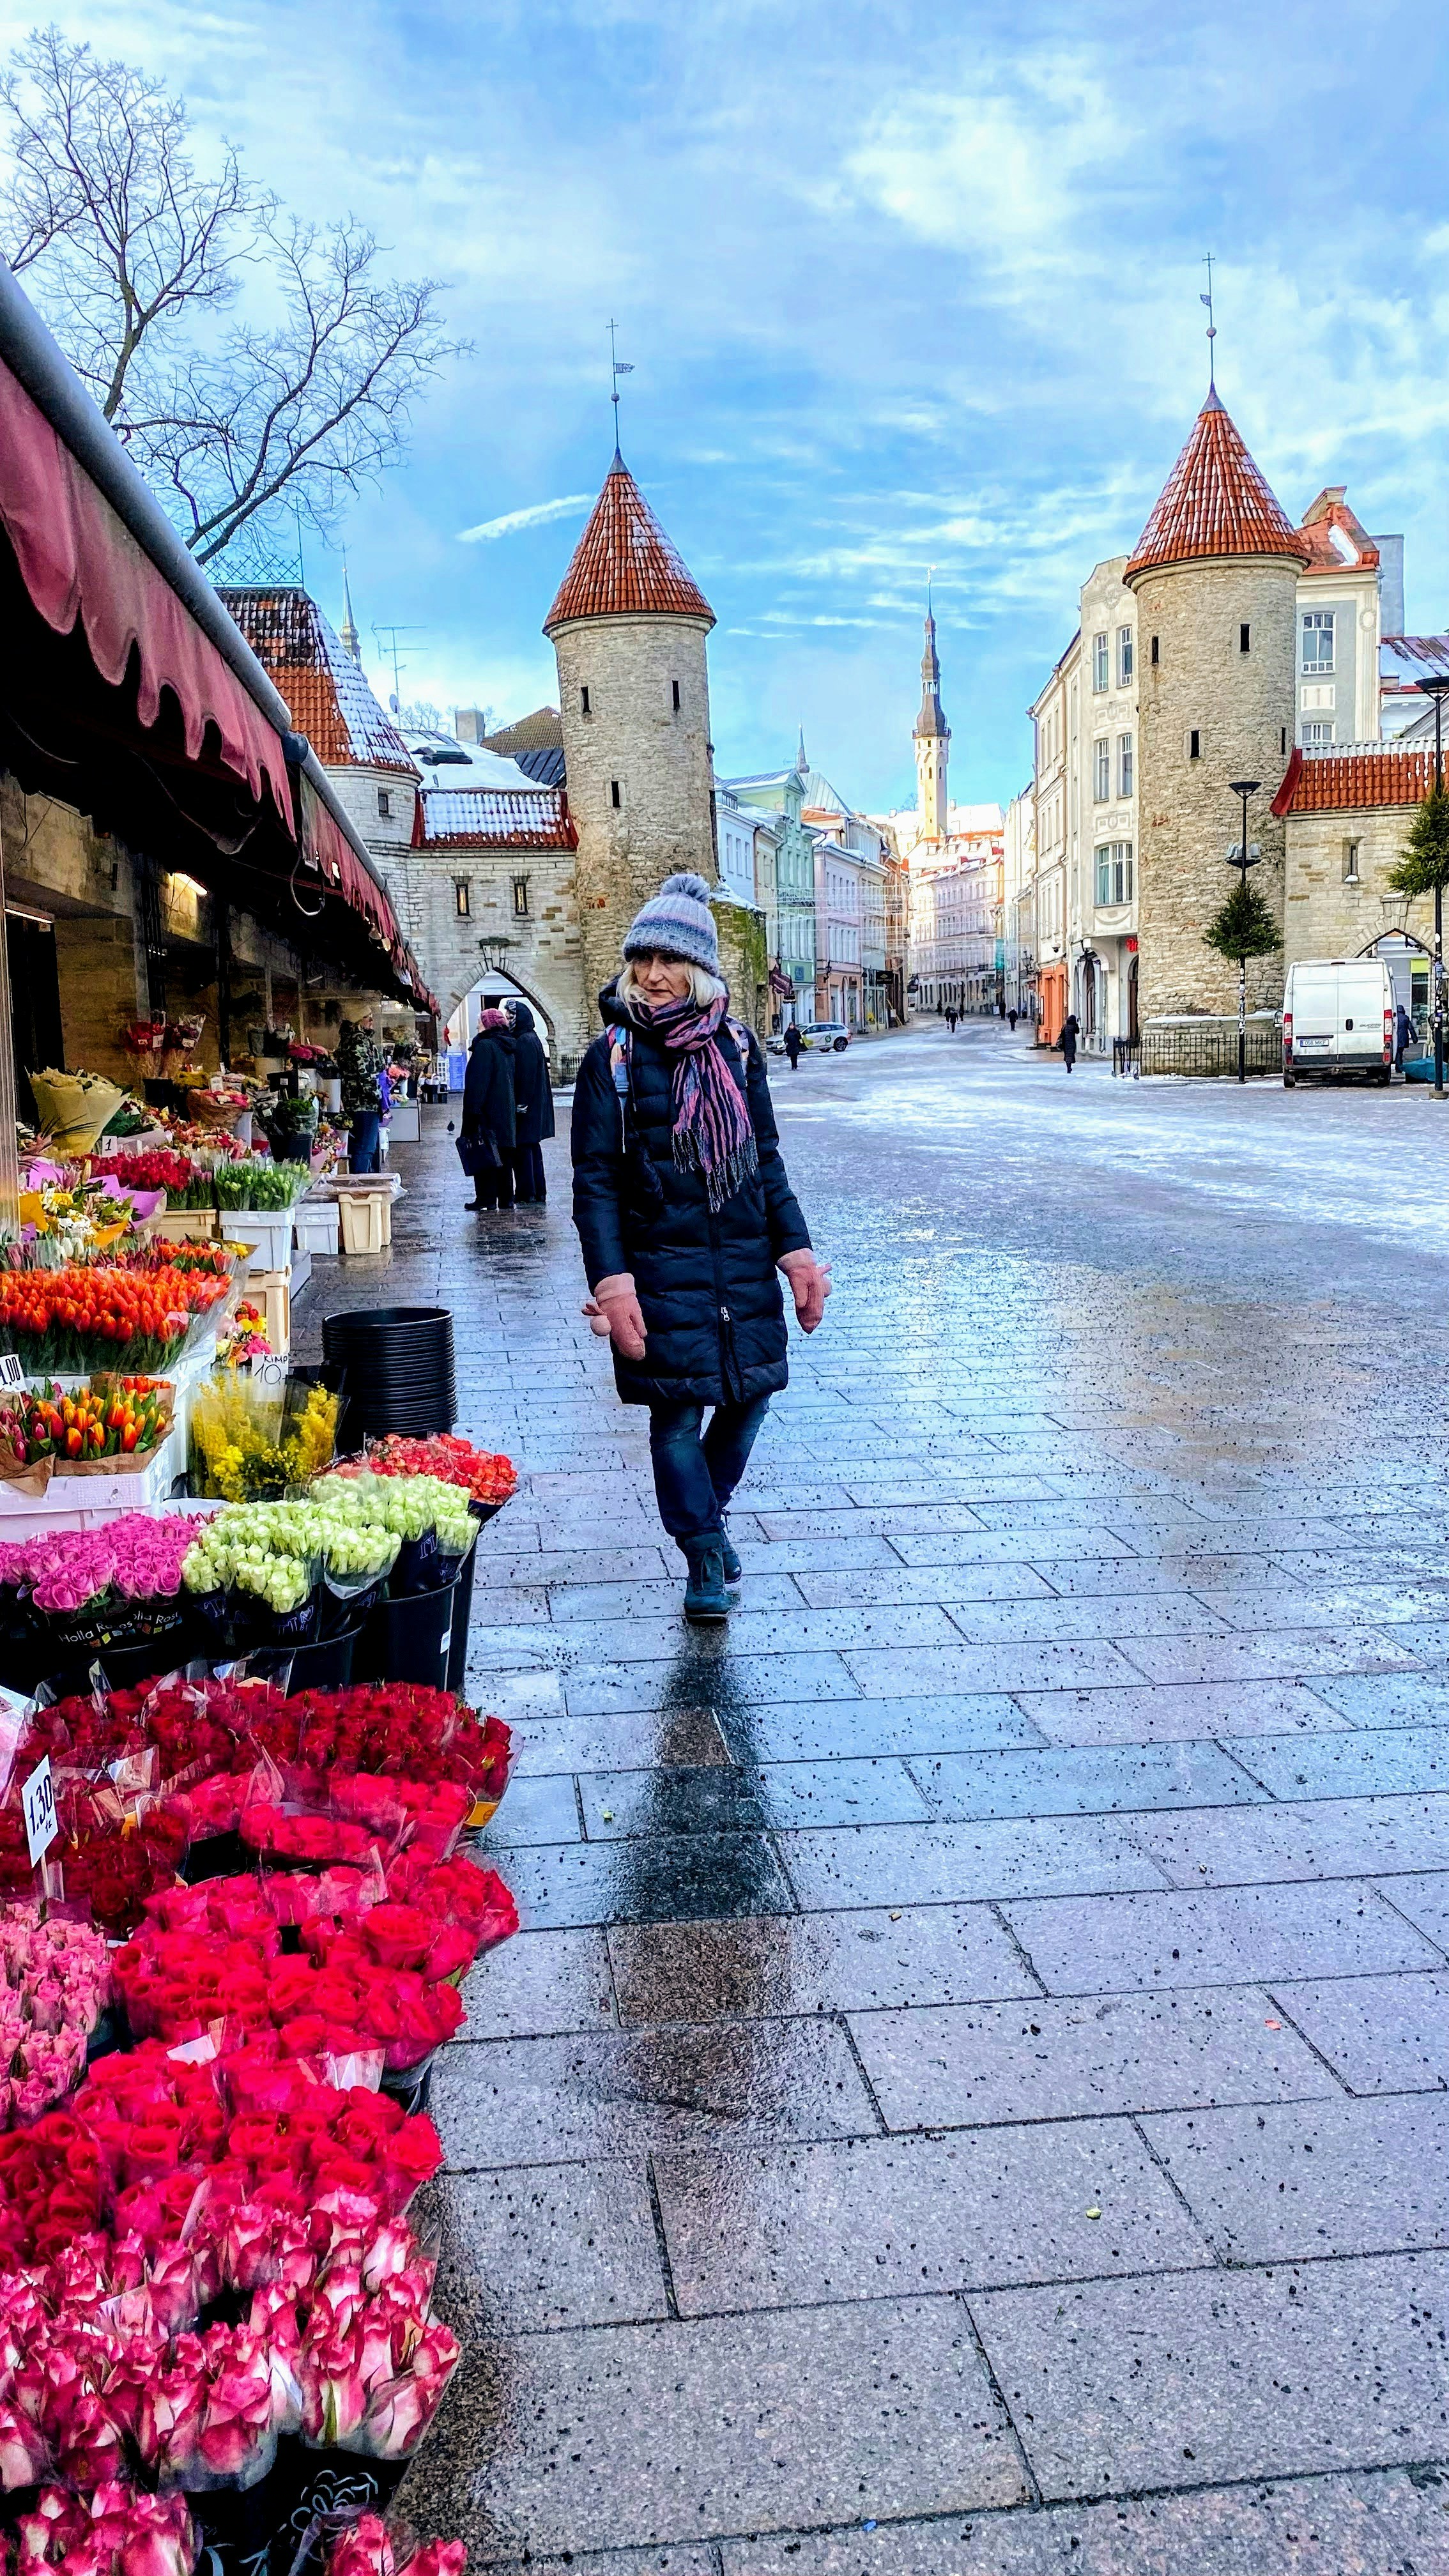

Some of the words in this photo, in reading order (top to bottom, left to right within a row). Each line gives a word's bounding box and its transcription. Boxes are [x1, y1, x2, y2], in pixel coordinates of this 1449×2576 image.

[263, 1354, 288, 1364] KIMP
[58, 1630, 94, 1643] Holla
[96, 1621, 133, 1633] Roes
